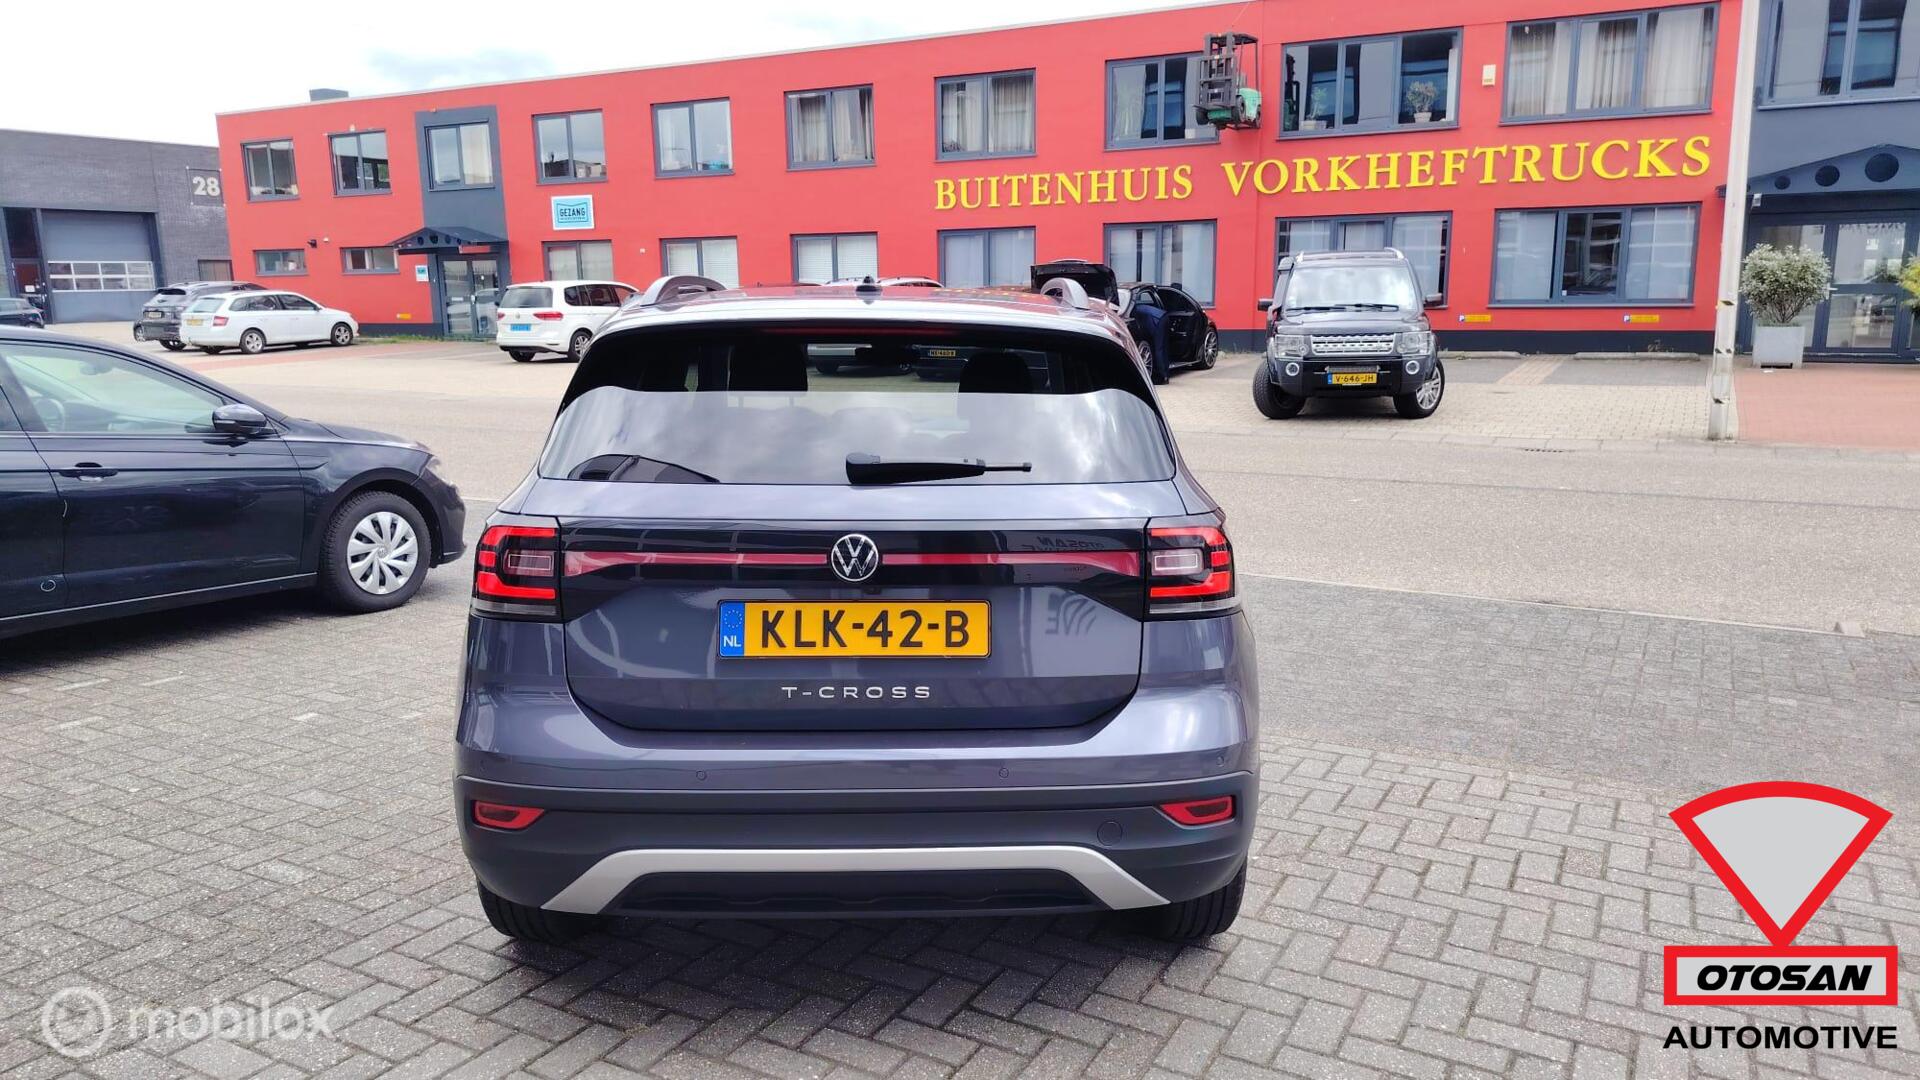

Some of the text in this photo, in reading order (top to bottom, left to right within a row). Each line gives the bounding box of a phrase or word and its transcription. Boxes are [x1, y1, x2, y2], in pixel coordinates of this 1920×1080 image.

[934, 135, 1712, 210] BUITENHUIS VORKHEFTRUCKS
[192, 176, 220, 197] 28
[560, 207, 586, 217] GEZANG
[761, 610, 969, 648] KLK-42-B
[723, 636, 741, 648] NL
[781, 686, 930, 699] T-CROSS
